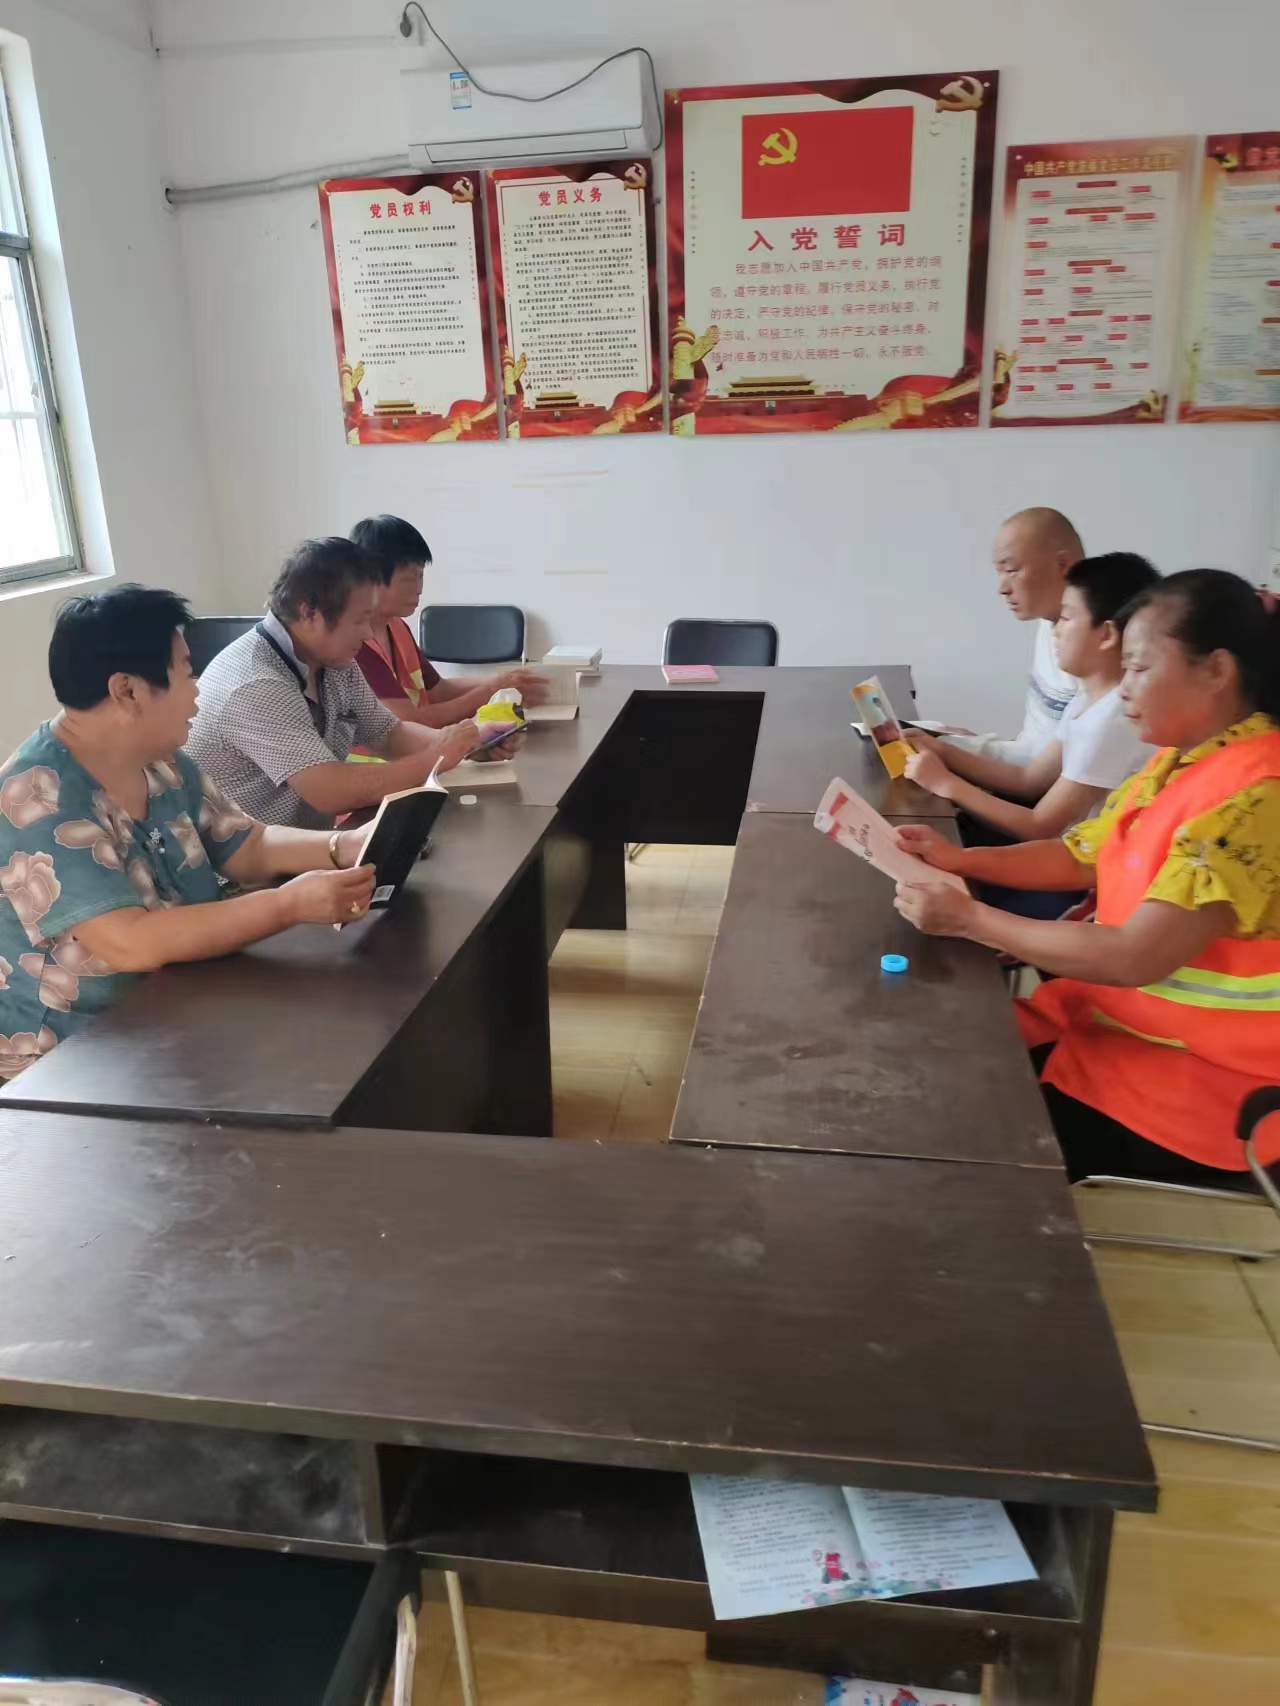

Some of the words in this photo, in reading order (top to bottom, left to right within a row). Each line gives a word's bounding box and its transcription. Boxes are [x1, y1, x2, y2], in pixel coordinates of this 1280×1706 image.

[538, 186, 602, 206] 党员义务
[370, 200, 431, 218] 党员权利
[747, 223, 905, 252] 入党誓词
